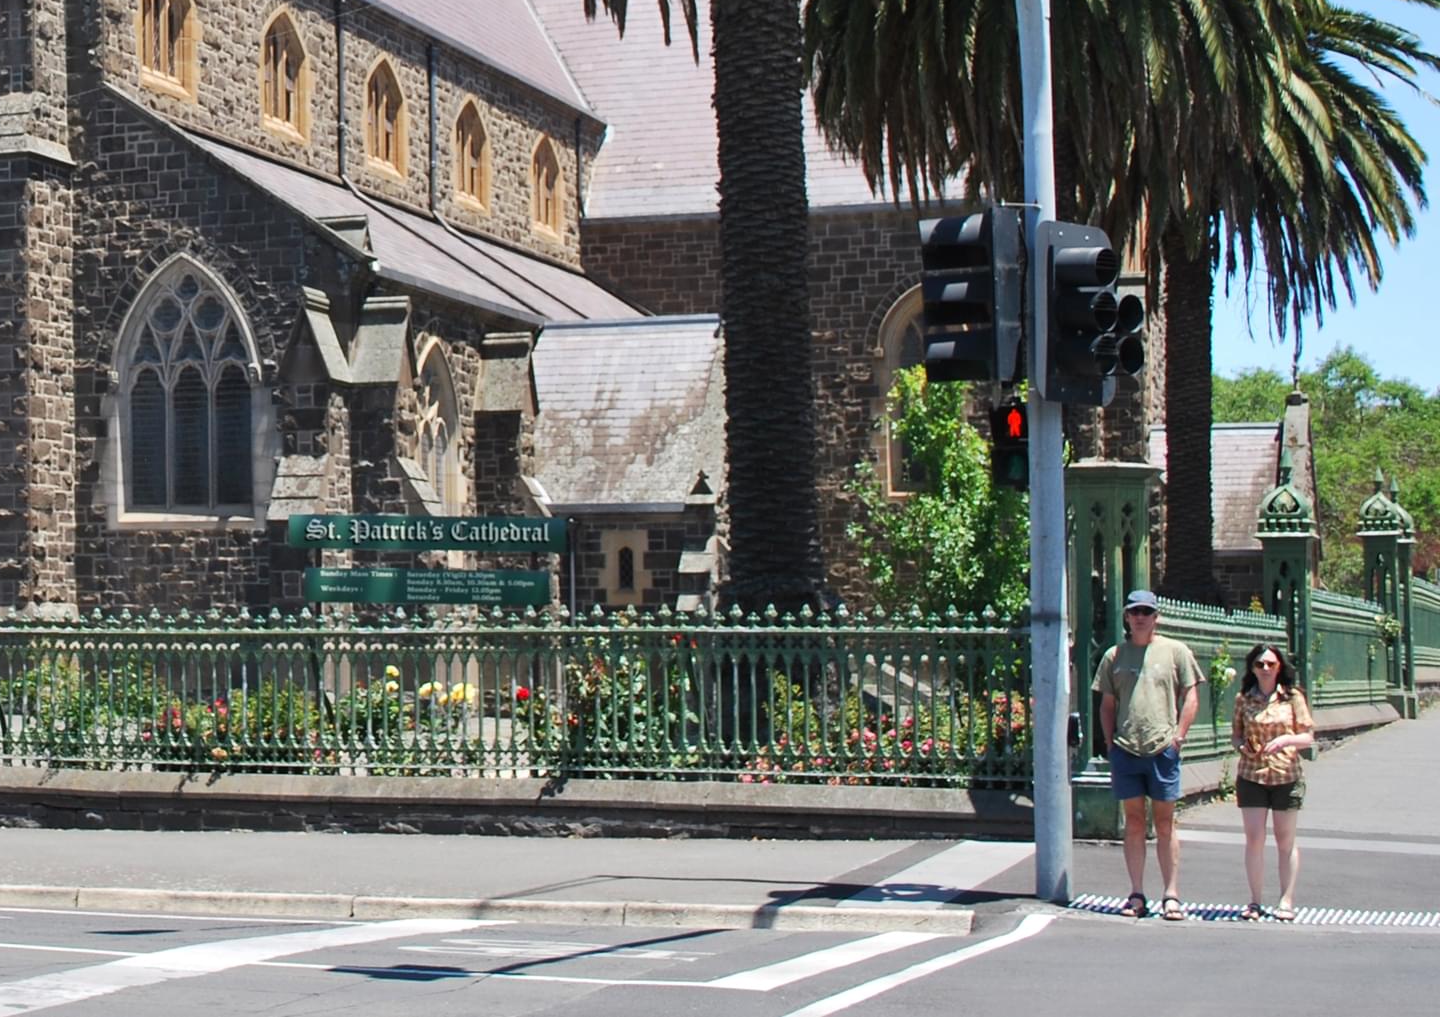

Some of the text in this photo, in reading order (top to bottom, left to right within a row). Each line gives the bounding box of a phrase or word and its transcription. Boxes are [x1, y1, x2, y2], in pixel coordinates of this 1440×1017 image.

[305, 518, 550, 545] St. Patrick's Cathedral
[320, 570, 347, 578] Sunday
[407, 571, 440, 579] Saturday
[407, 586, 437, 594] Monday
[407, 594, 440, 602] Saturday
